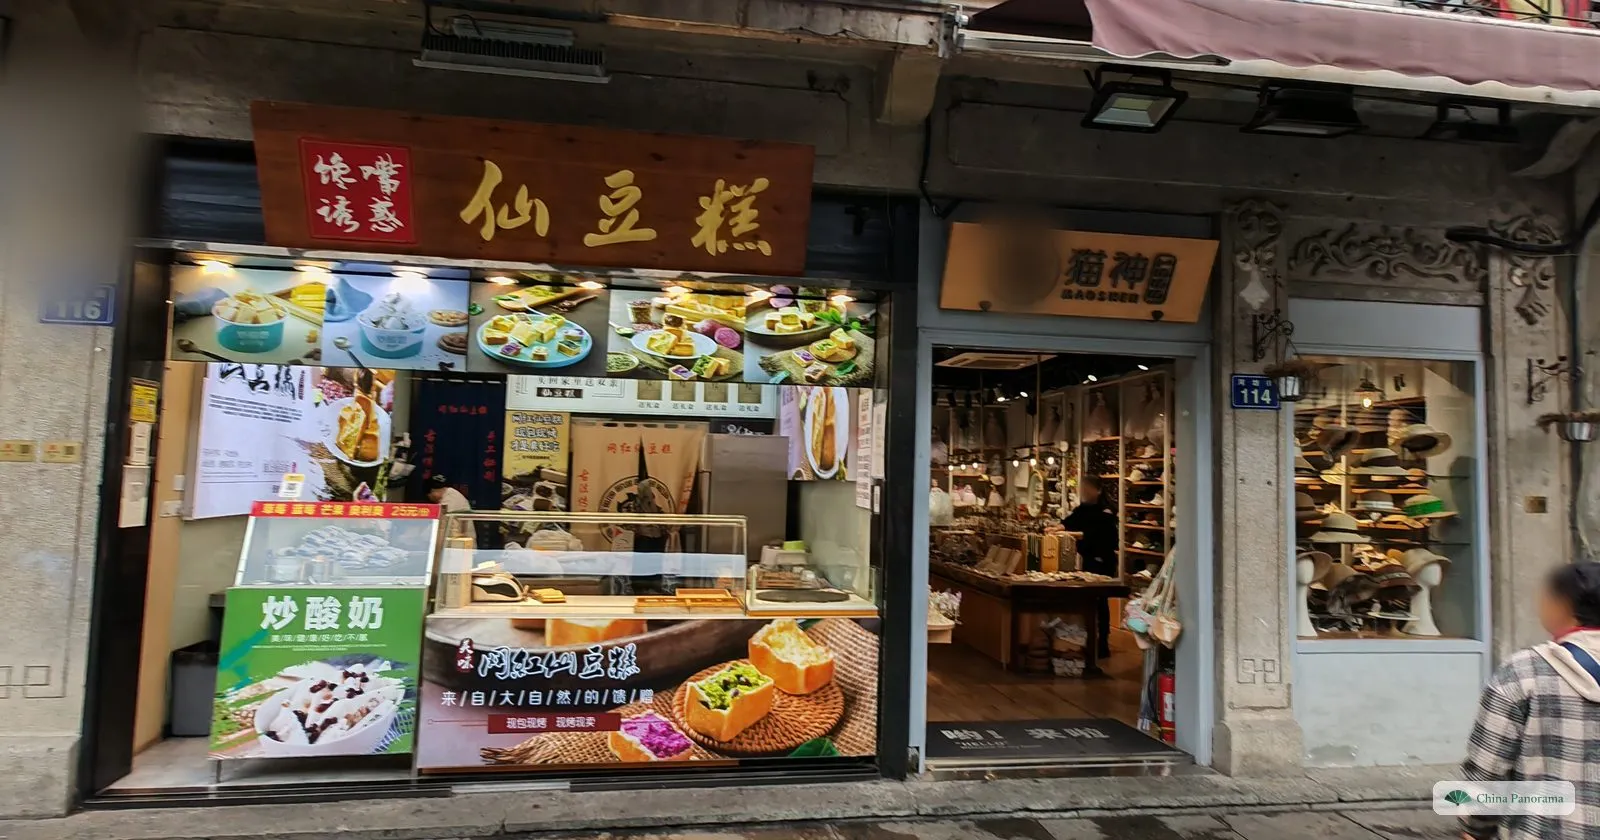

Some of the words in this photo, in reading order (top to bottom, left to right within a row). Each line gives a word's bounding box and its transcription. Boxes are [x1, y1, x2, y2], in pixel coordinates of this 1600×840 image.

[459, 159, 773, 257] 仙豆糕
[1064, 247, 1149, 290] 猫神
[1240, 387, 1272, 405] 114
[320, 503, 344, 516] 芒果
[349, 504, 384, 517] 奥利奥
[260, 595, 385, 632] 炒酸奶
[457, 637, 475, 670] 美味
[506, 716, 548, 729] 现包现烤
